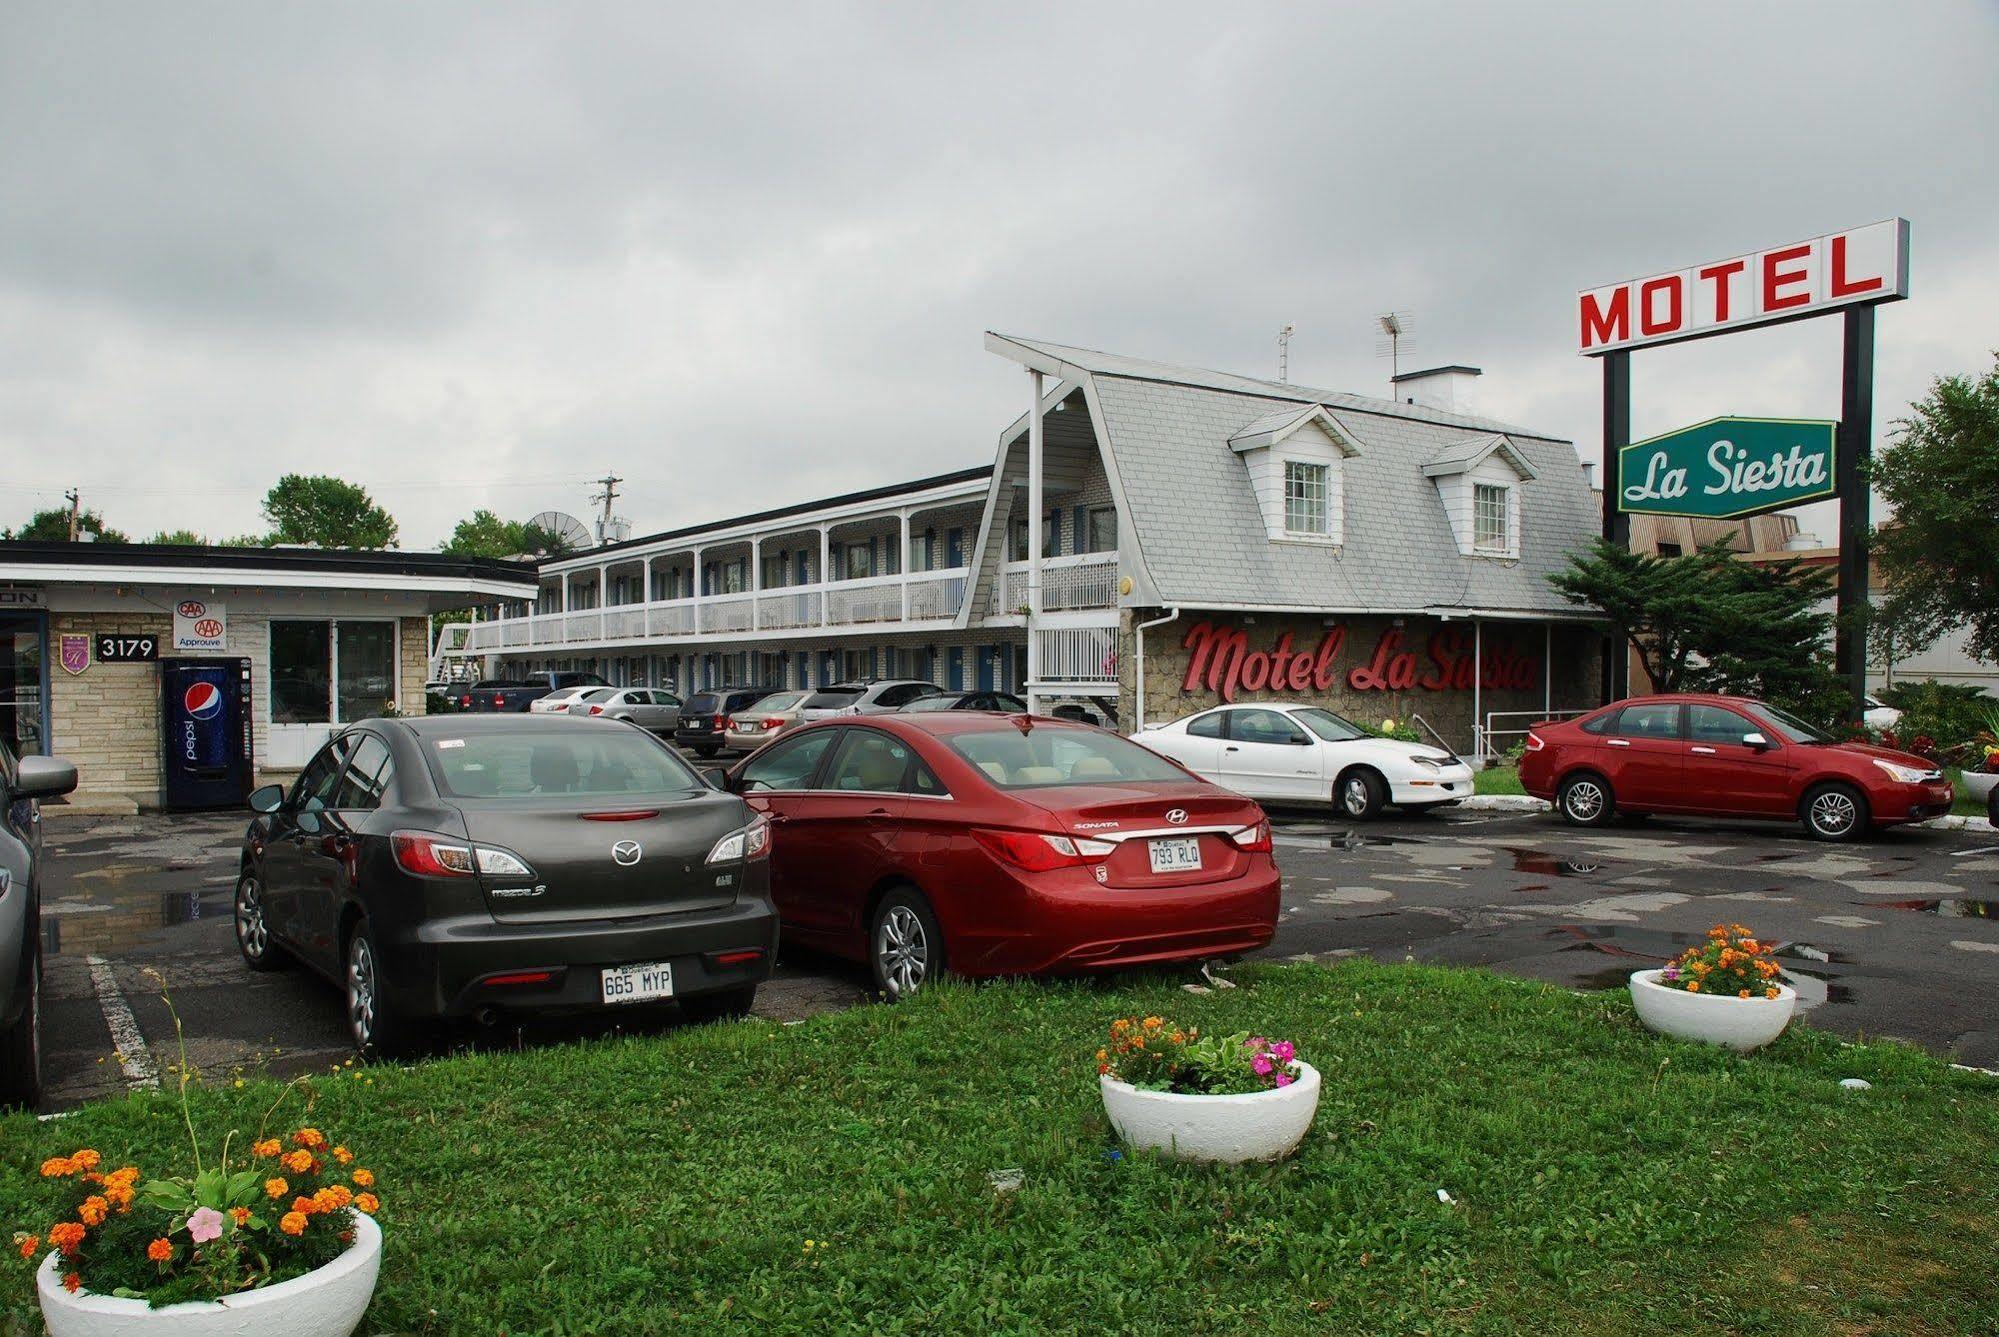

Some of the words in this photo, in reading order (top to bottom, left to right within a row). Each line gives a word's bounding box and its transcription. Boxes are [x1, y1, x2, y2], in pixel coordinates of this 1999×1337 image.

[1580, 236, 1882, 348] MOTEL
[1623, 451, 1688, 501] La
[1703, 440, 1828, 495] Siesta
[180, 603, 203, 616] CAA
[198, 621, 220, 637] AAA
[102, 639, 153, 657] 3179
[1182, 621, 1345, 704] Motel
[1349, 629, 1416, 691] La
[184, 720, 197, 760] pepsi
[1073, 821, 1119, 829] SONATA
[1152, 848, 1173, 865] 793
[1178, 846, 1198, 863] RLQ
[605, 975, 633, 996] 665
[642, 971, 670, 991] MYP
